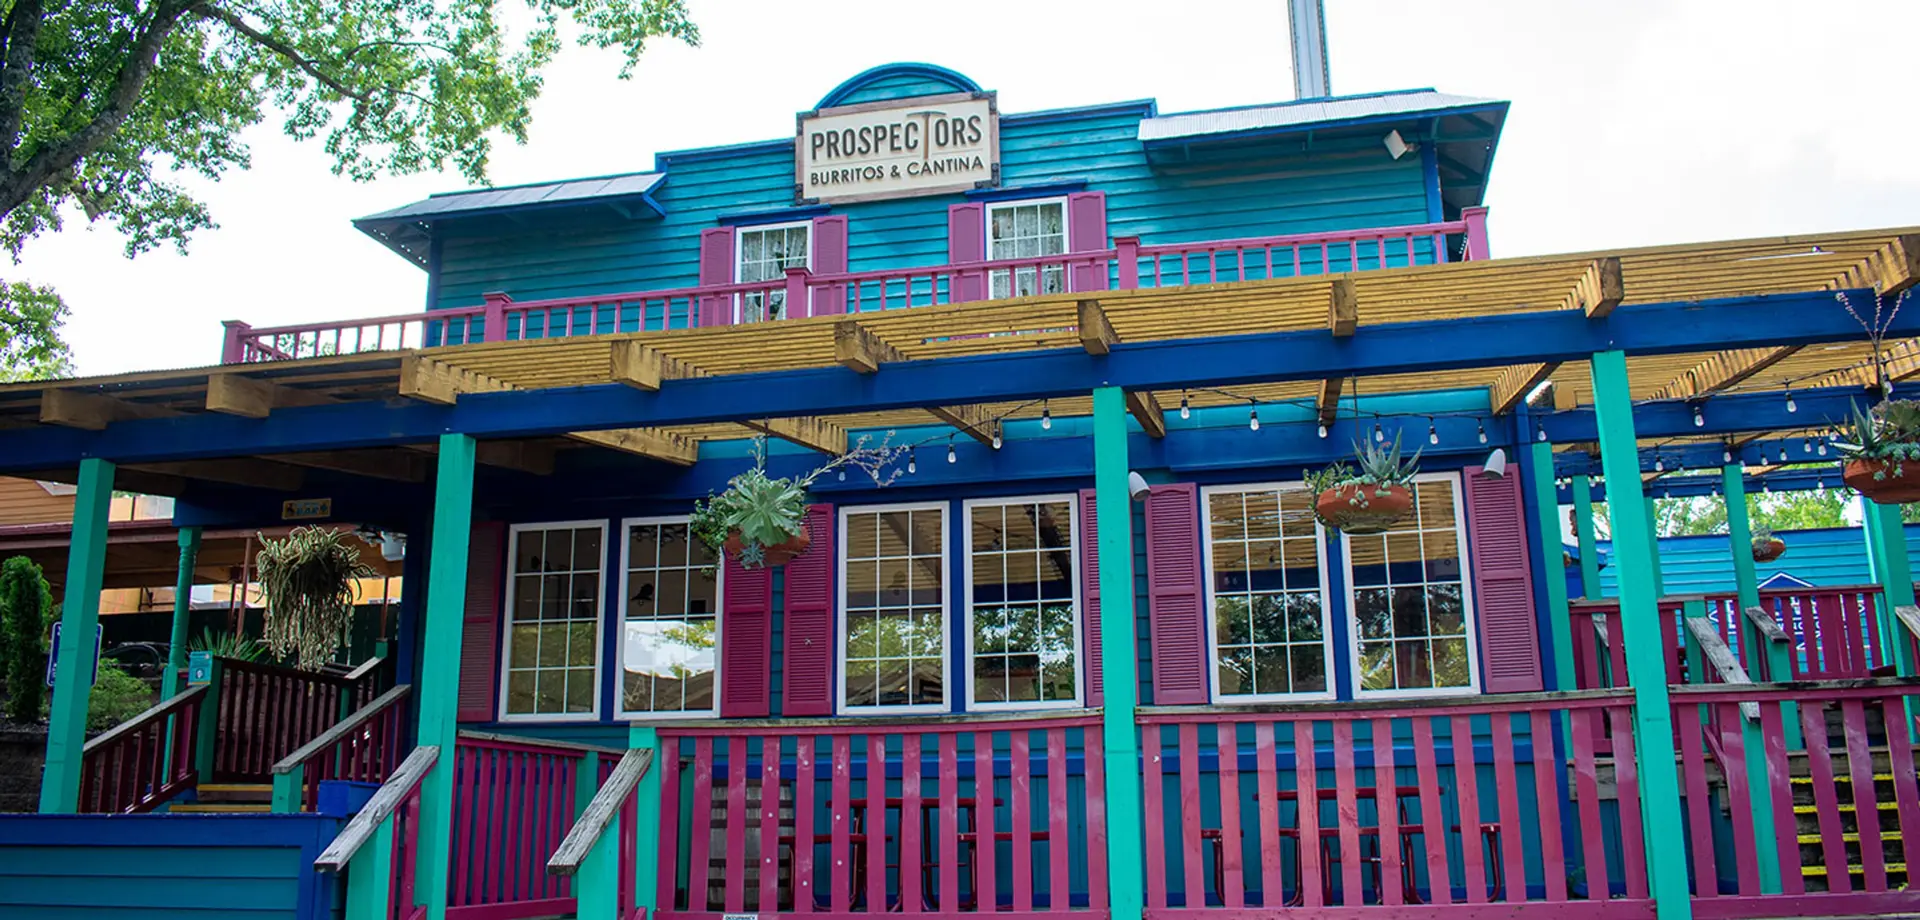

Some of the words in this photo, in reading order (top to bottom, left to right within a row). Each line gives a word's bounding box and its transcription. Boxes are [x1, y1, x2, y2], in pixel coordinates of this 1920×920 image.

[811, 111, 982, 161] PROSPECTORS
[810, 165, 884, 185] BURRITOS
[890, 165, 901, 177] &
[906, 156, 983, 176] CANTINA
